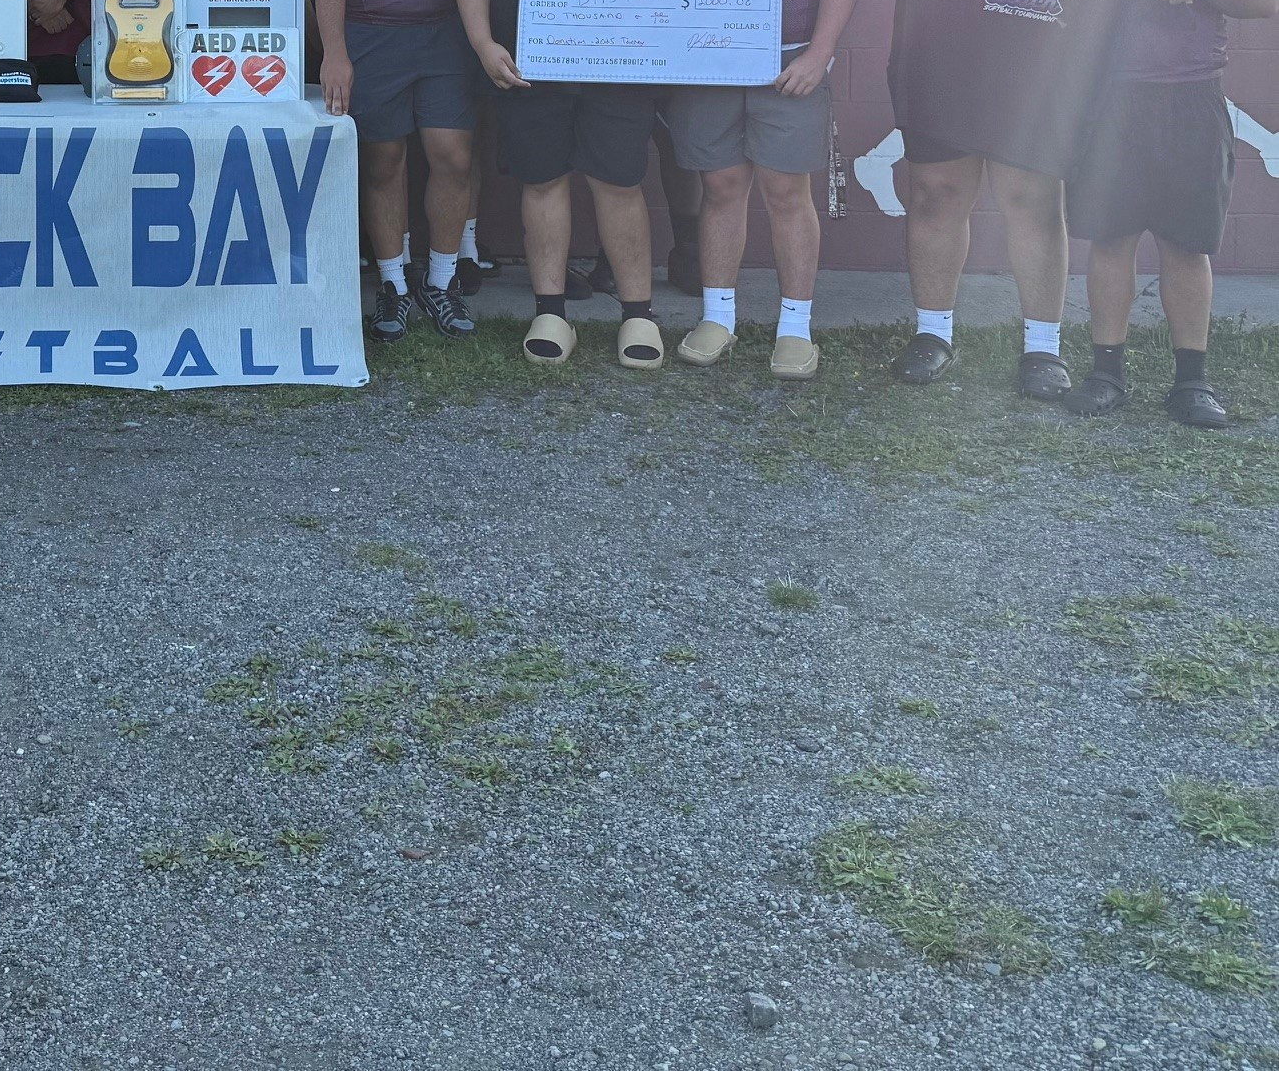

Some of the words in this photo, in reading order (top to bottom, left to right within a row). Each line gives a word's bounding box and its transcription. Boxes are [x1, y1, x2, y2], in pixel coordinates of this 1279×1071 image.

[529, 10, 556, 20] TWO
[983, 5, 1013, 15] SOFTBALL
[1014, 9, 1058, 23] TOURNAMENT
[191, 33, 237, 53] AED
[240, 32, 286, 53] AED
[131, 124, 334, 289] BAY
